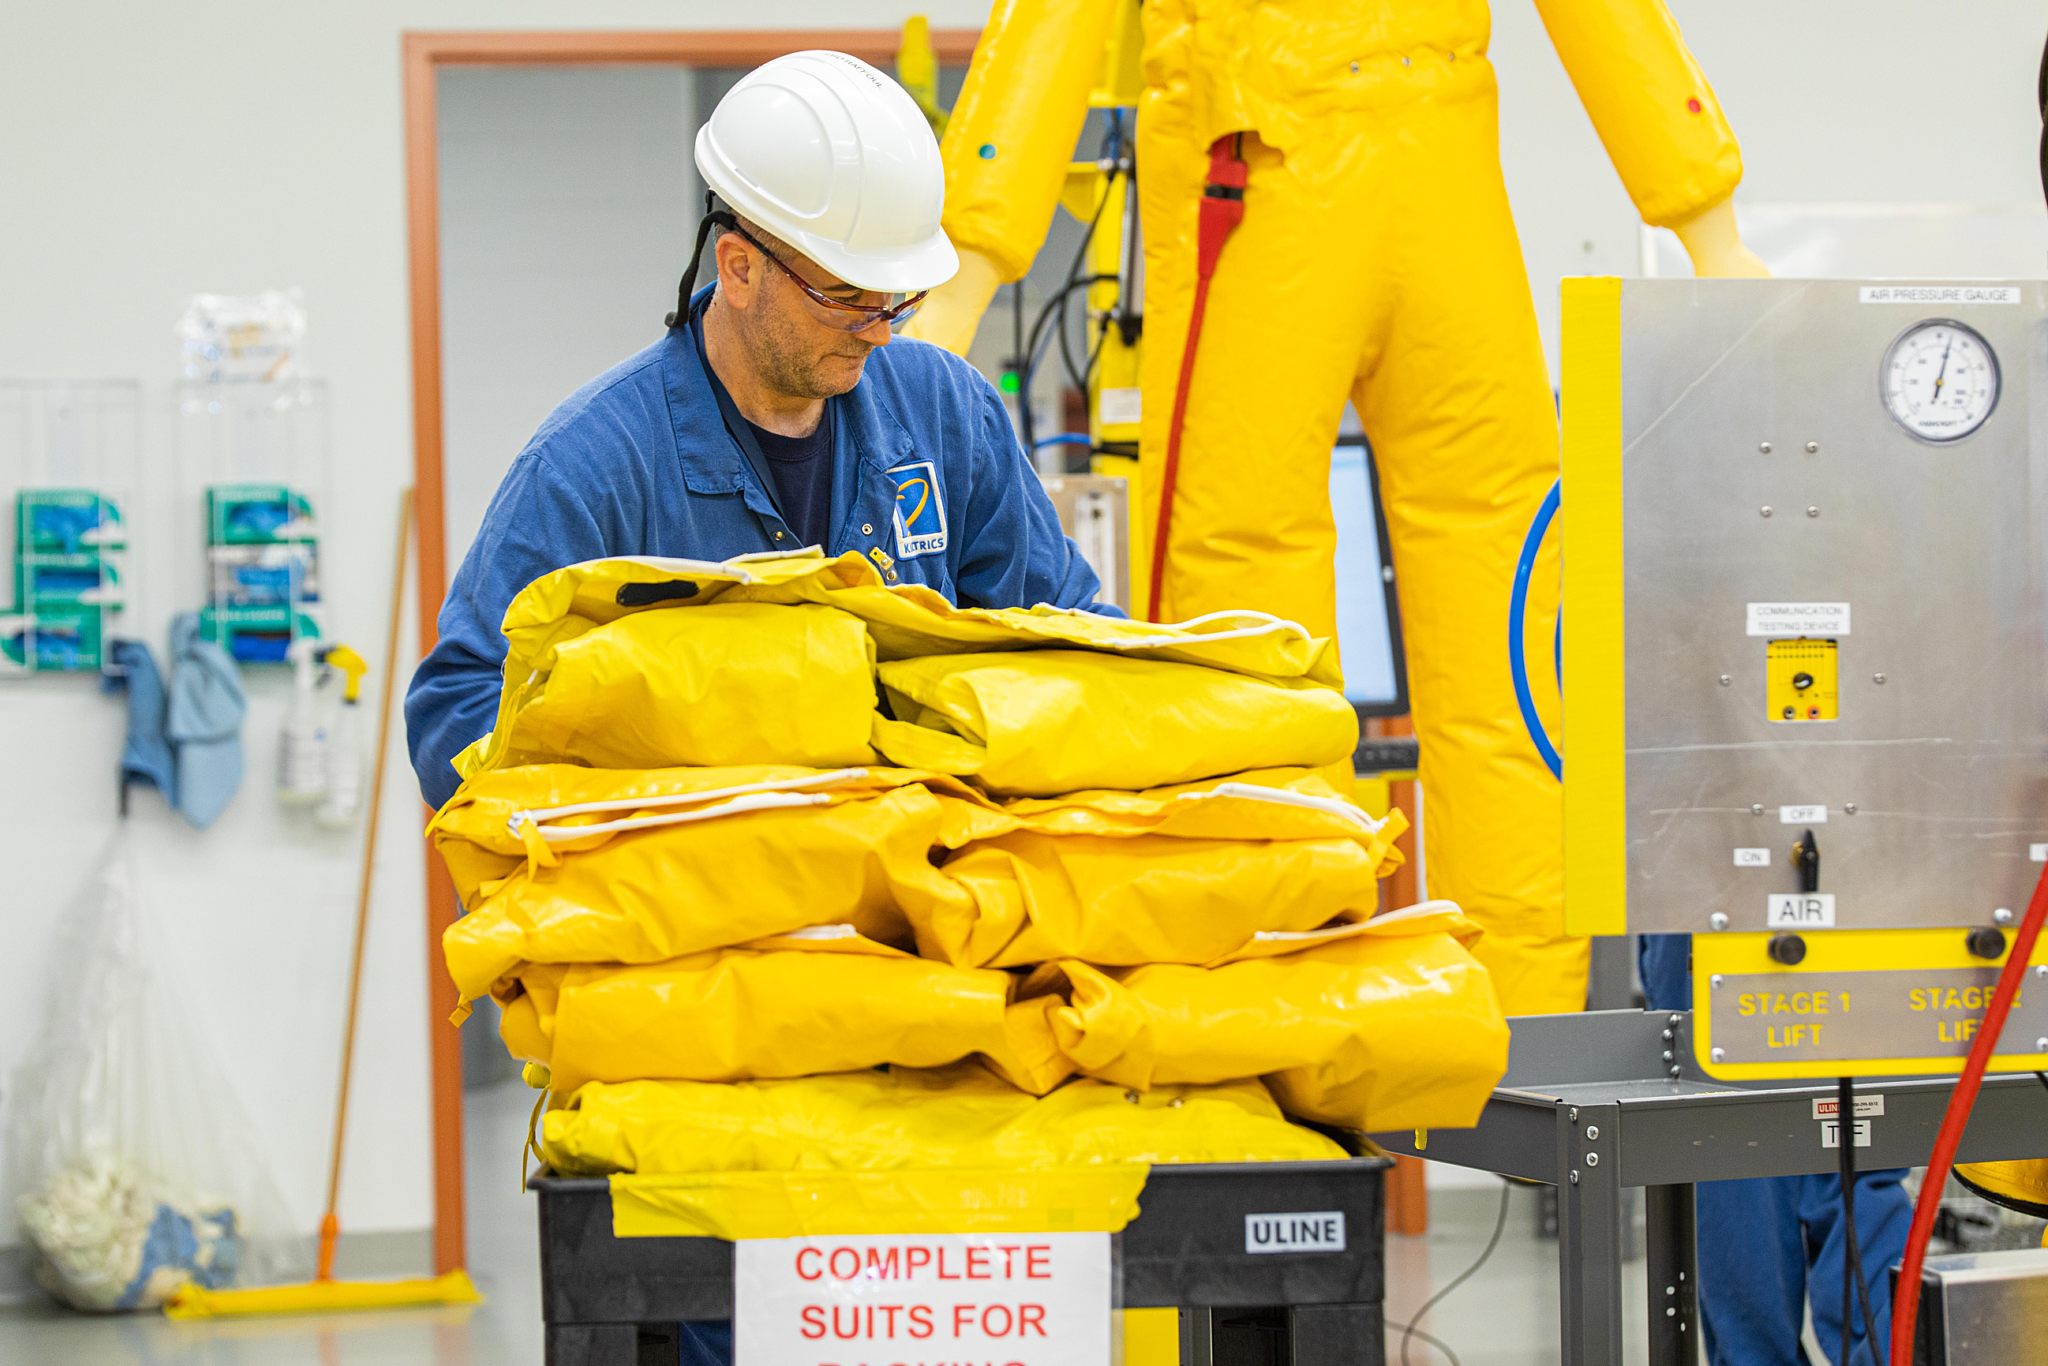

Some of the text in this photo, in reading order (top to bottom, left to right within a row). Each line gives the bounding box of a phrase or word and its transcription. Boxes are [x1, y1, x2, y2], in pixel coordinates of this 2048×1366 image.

[1869, 289, 2009, 301] AIR PRESSURE GAUGE
[1758, 621, 1839, 631] TESTING DEVICE
[1790, 808, 1815, 820] OFF
[1741, 850, 1762, 862] ON
[1779, 899, 1823, 921] AIR
[1739, 991, 1850, 1016] STAGE 1
[1767, 1024, 1824, 1048] LIFT
[1938, 1018, 1984, 1042] LIF
[1818, 1103, 1839, 1113] ULIN
[1253, 1220, 1337, 1244] ULINE
[795, 1244, 1052, 1282] COMPLETE
[800, 1303, 1048, 1340] SUITS FOR
